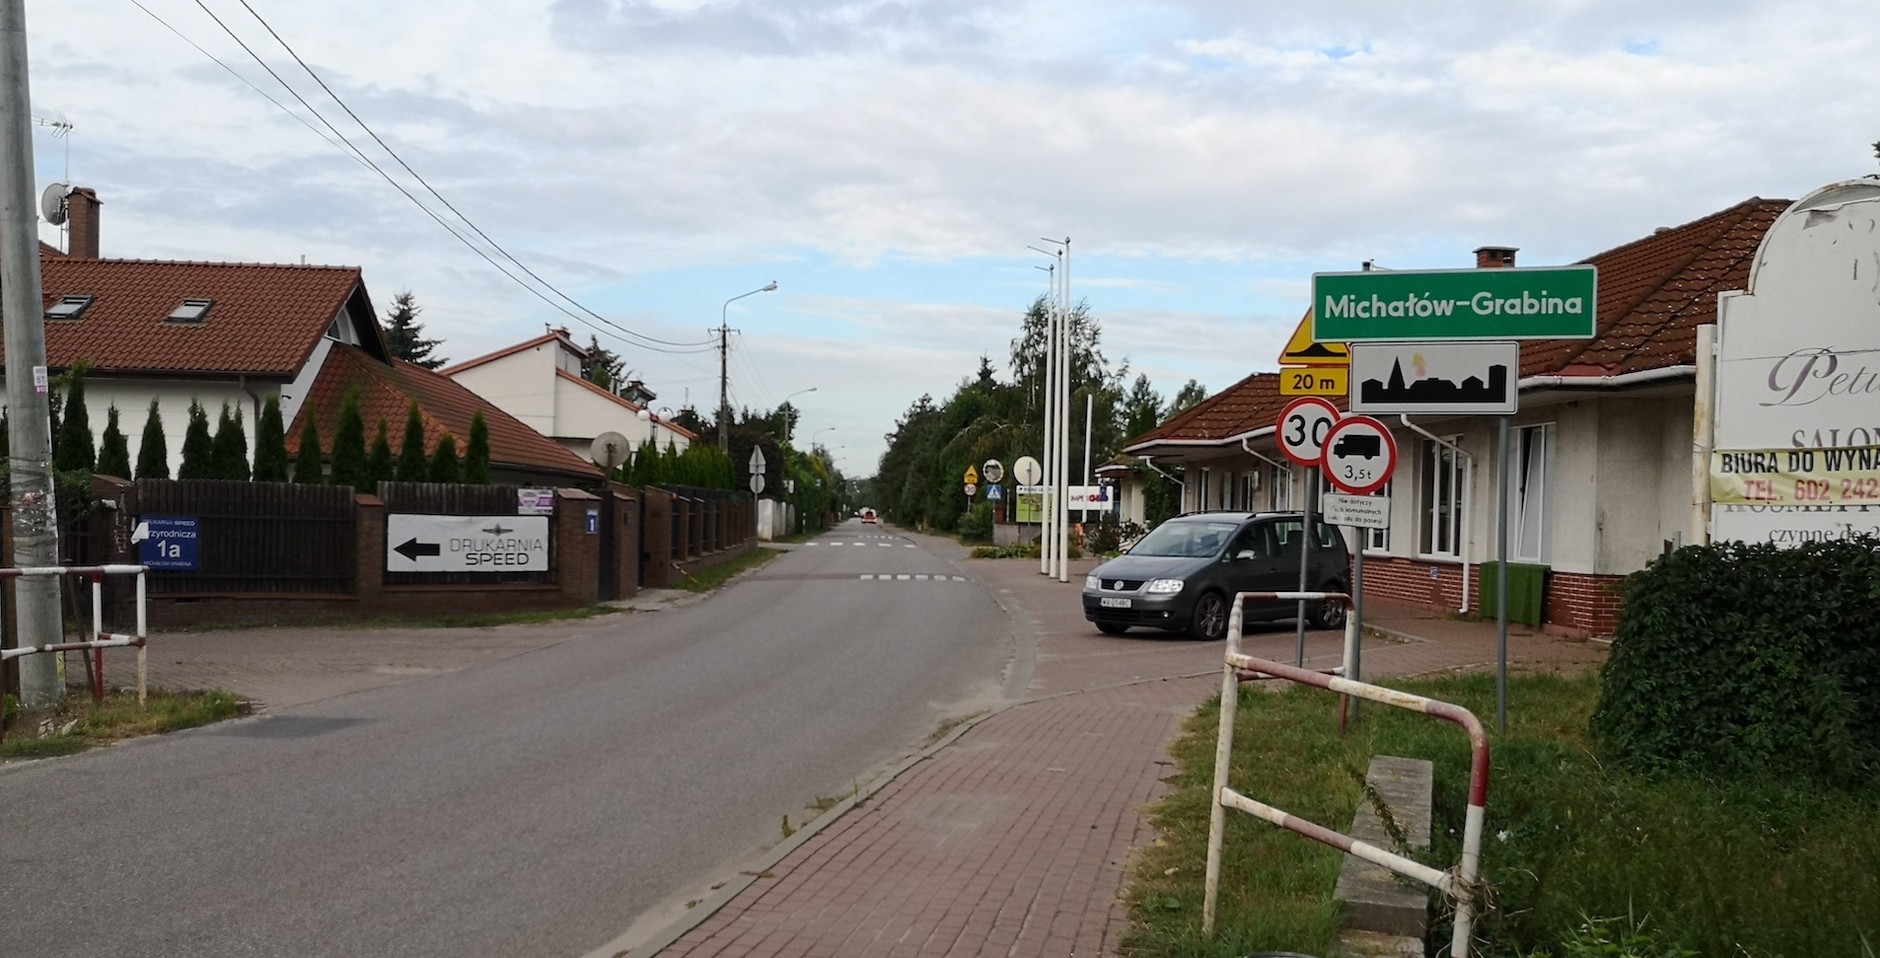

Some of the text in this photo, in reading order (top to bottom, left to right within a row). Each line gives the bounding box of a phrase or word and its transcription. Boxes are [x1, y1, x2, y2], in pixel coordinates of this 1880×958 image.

[1324, 290, 1582, 319] Michałów-Grabina
[1292, 374, 1335, 390] 20 m
[1285, 414, 1333, 448] 30
[1720, 452, 1779, 474] BIURA
[1788, 450, 1814, 473] DO
[1743, 477, 1879, 501] TEL. 602 242
[157, 540, 181, 558] 1a
[450, 538, 544, 552] DRUKARNIA
[466, 552, 530, 566] SPEED
